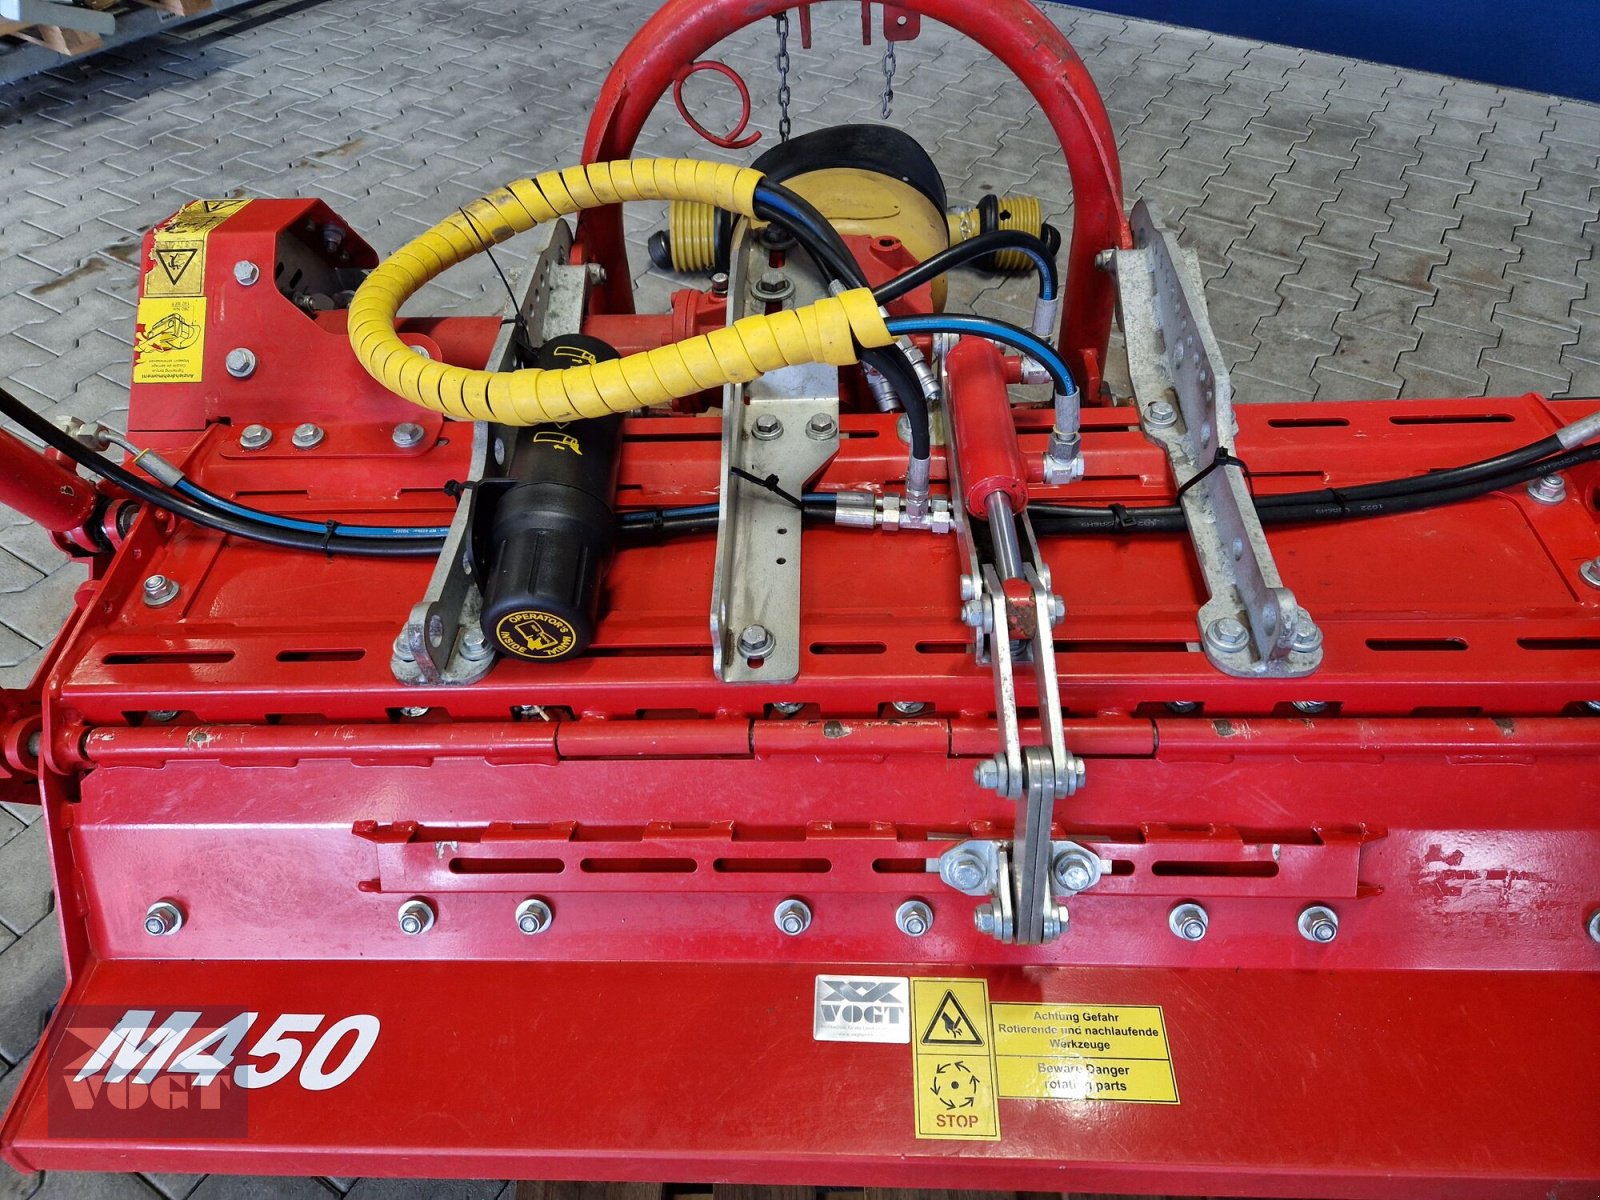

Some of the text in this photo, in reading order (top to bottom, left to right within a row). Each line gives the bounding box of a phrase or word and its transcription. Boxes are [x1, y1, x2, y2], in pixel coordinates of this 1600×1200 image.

[508, 613, 569, 633] OPERATOR'S
[501, 631, 528, 654] INSIDE
[819, 1004, 904, 1024] VOGT
[1034, 1011, 1119, 1023] Achtung Gefahr
[998, 1024, 1159, 1037] Rotierende und nachlaufende
[72, 1009, 381, 1091] M450
[1050, 1039, 1111, 1051] Werkzeuge
[1086, 1064, 1130, 1077] Danger
[1095, 1079, 1127, 1093] parts
[936, 1114, 979, 1129] STOP
